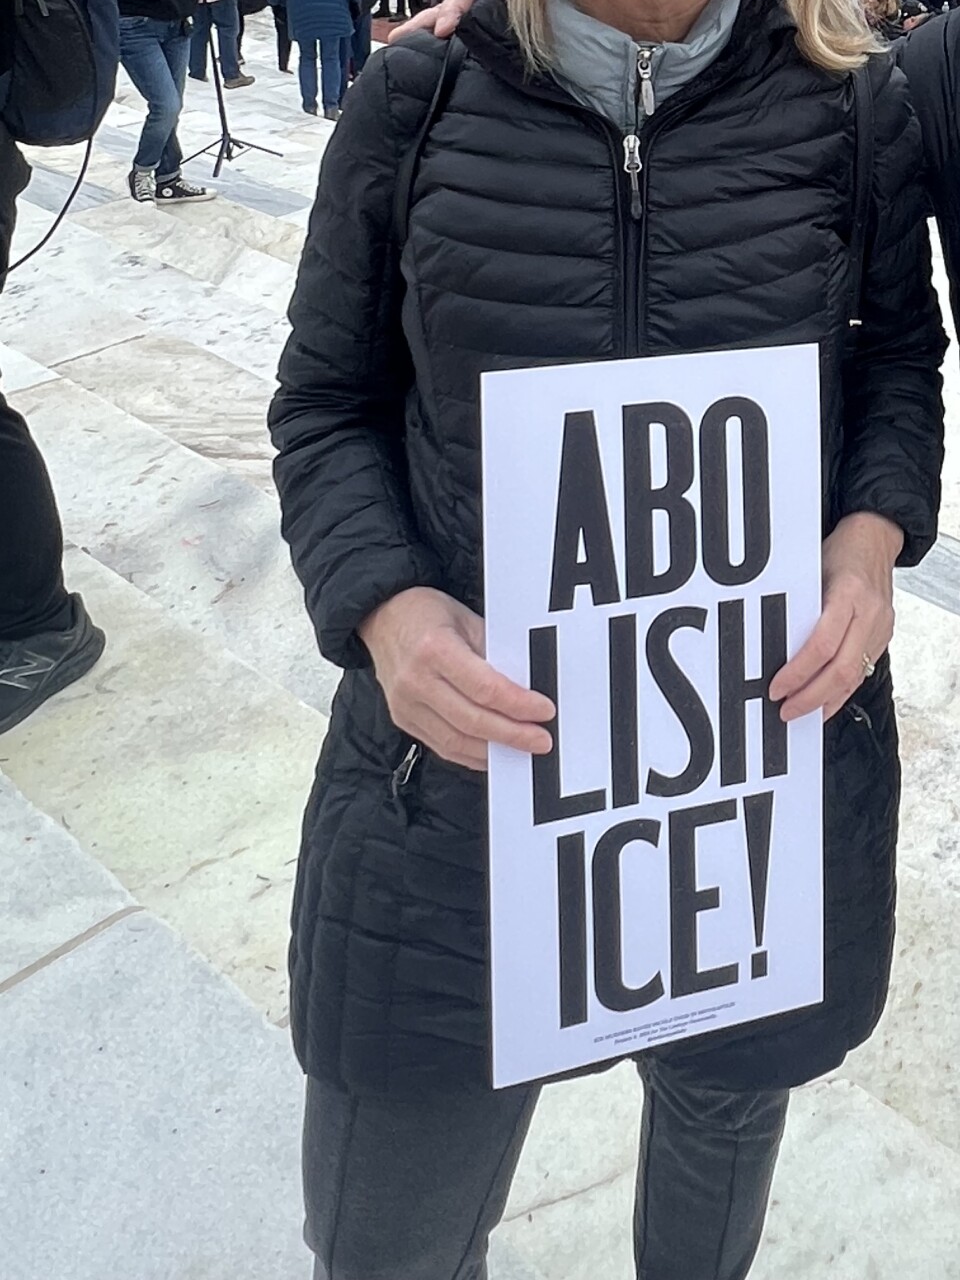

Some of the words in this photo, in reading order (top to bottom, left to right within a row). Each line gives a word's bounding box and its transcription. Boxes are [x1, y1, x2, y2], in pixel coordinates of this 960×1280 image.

[548, 396, 771, 613] ABO
[529, 592, 788, 826] LISH
[557, 790, 775, 1030] ICE!
